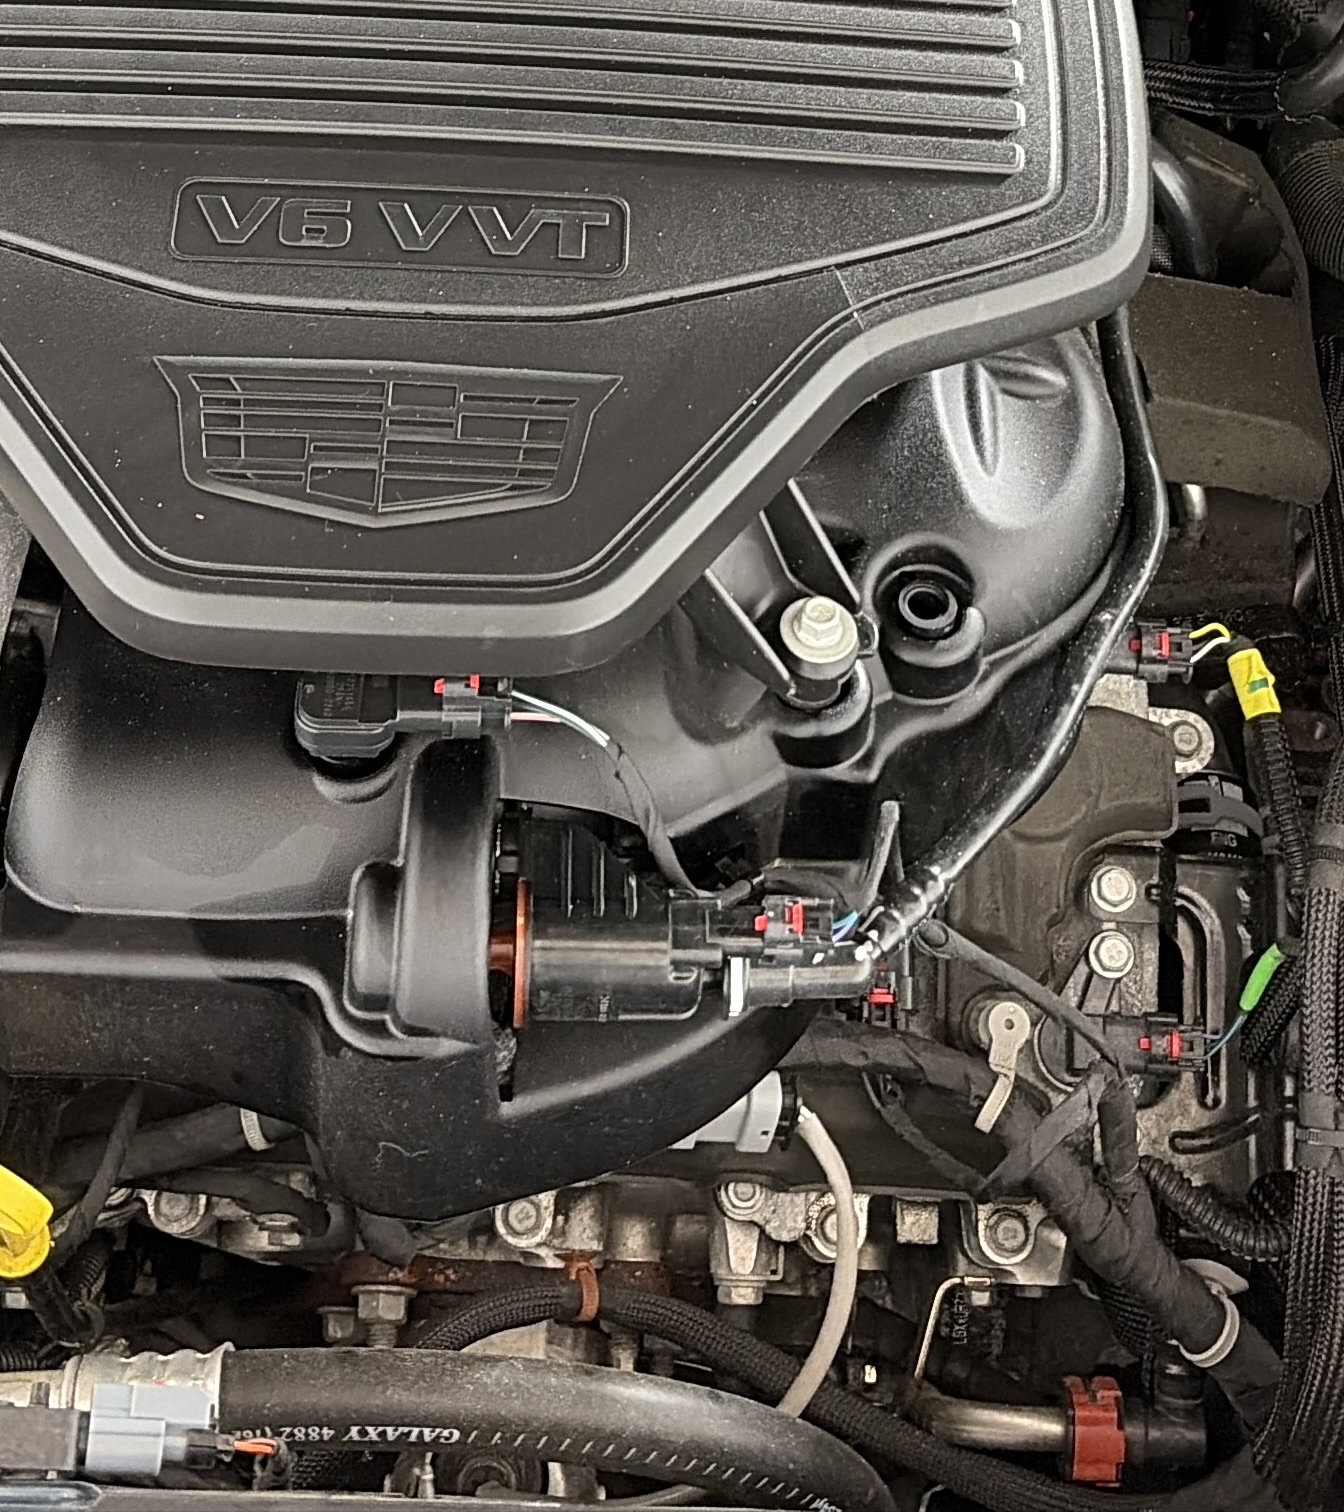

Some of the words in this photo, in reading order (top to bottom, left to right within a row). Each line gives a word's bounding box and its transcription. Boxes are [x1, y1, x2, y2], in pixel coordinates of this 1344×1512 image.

[196, 195, 352, 248] V6
[378, 201, 610, 260] VVT
[280, 1425, 337, 1443] 4882
[342, 1425, 462, 1445] GALAXY
